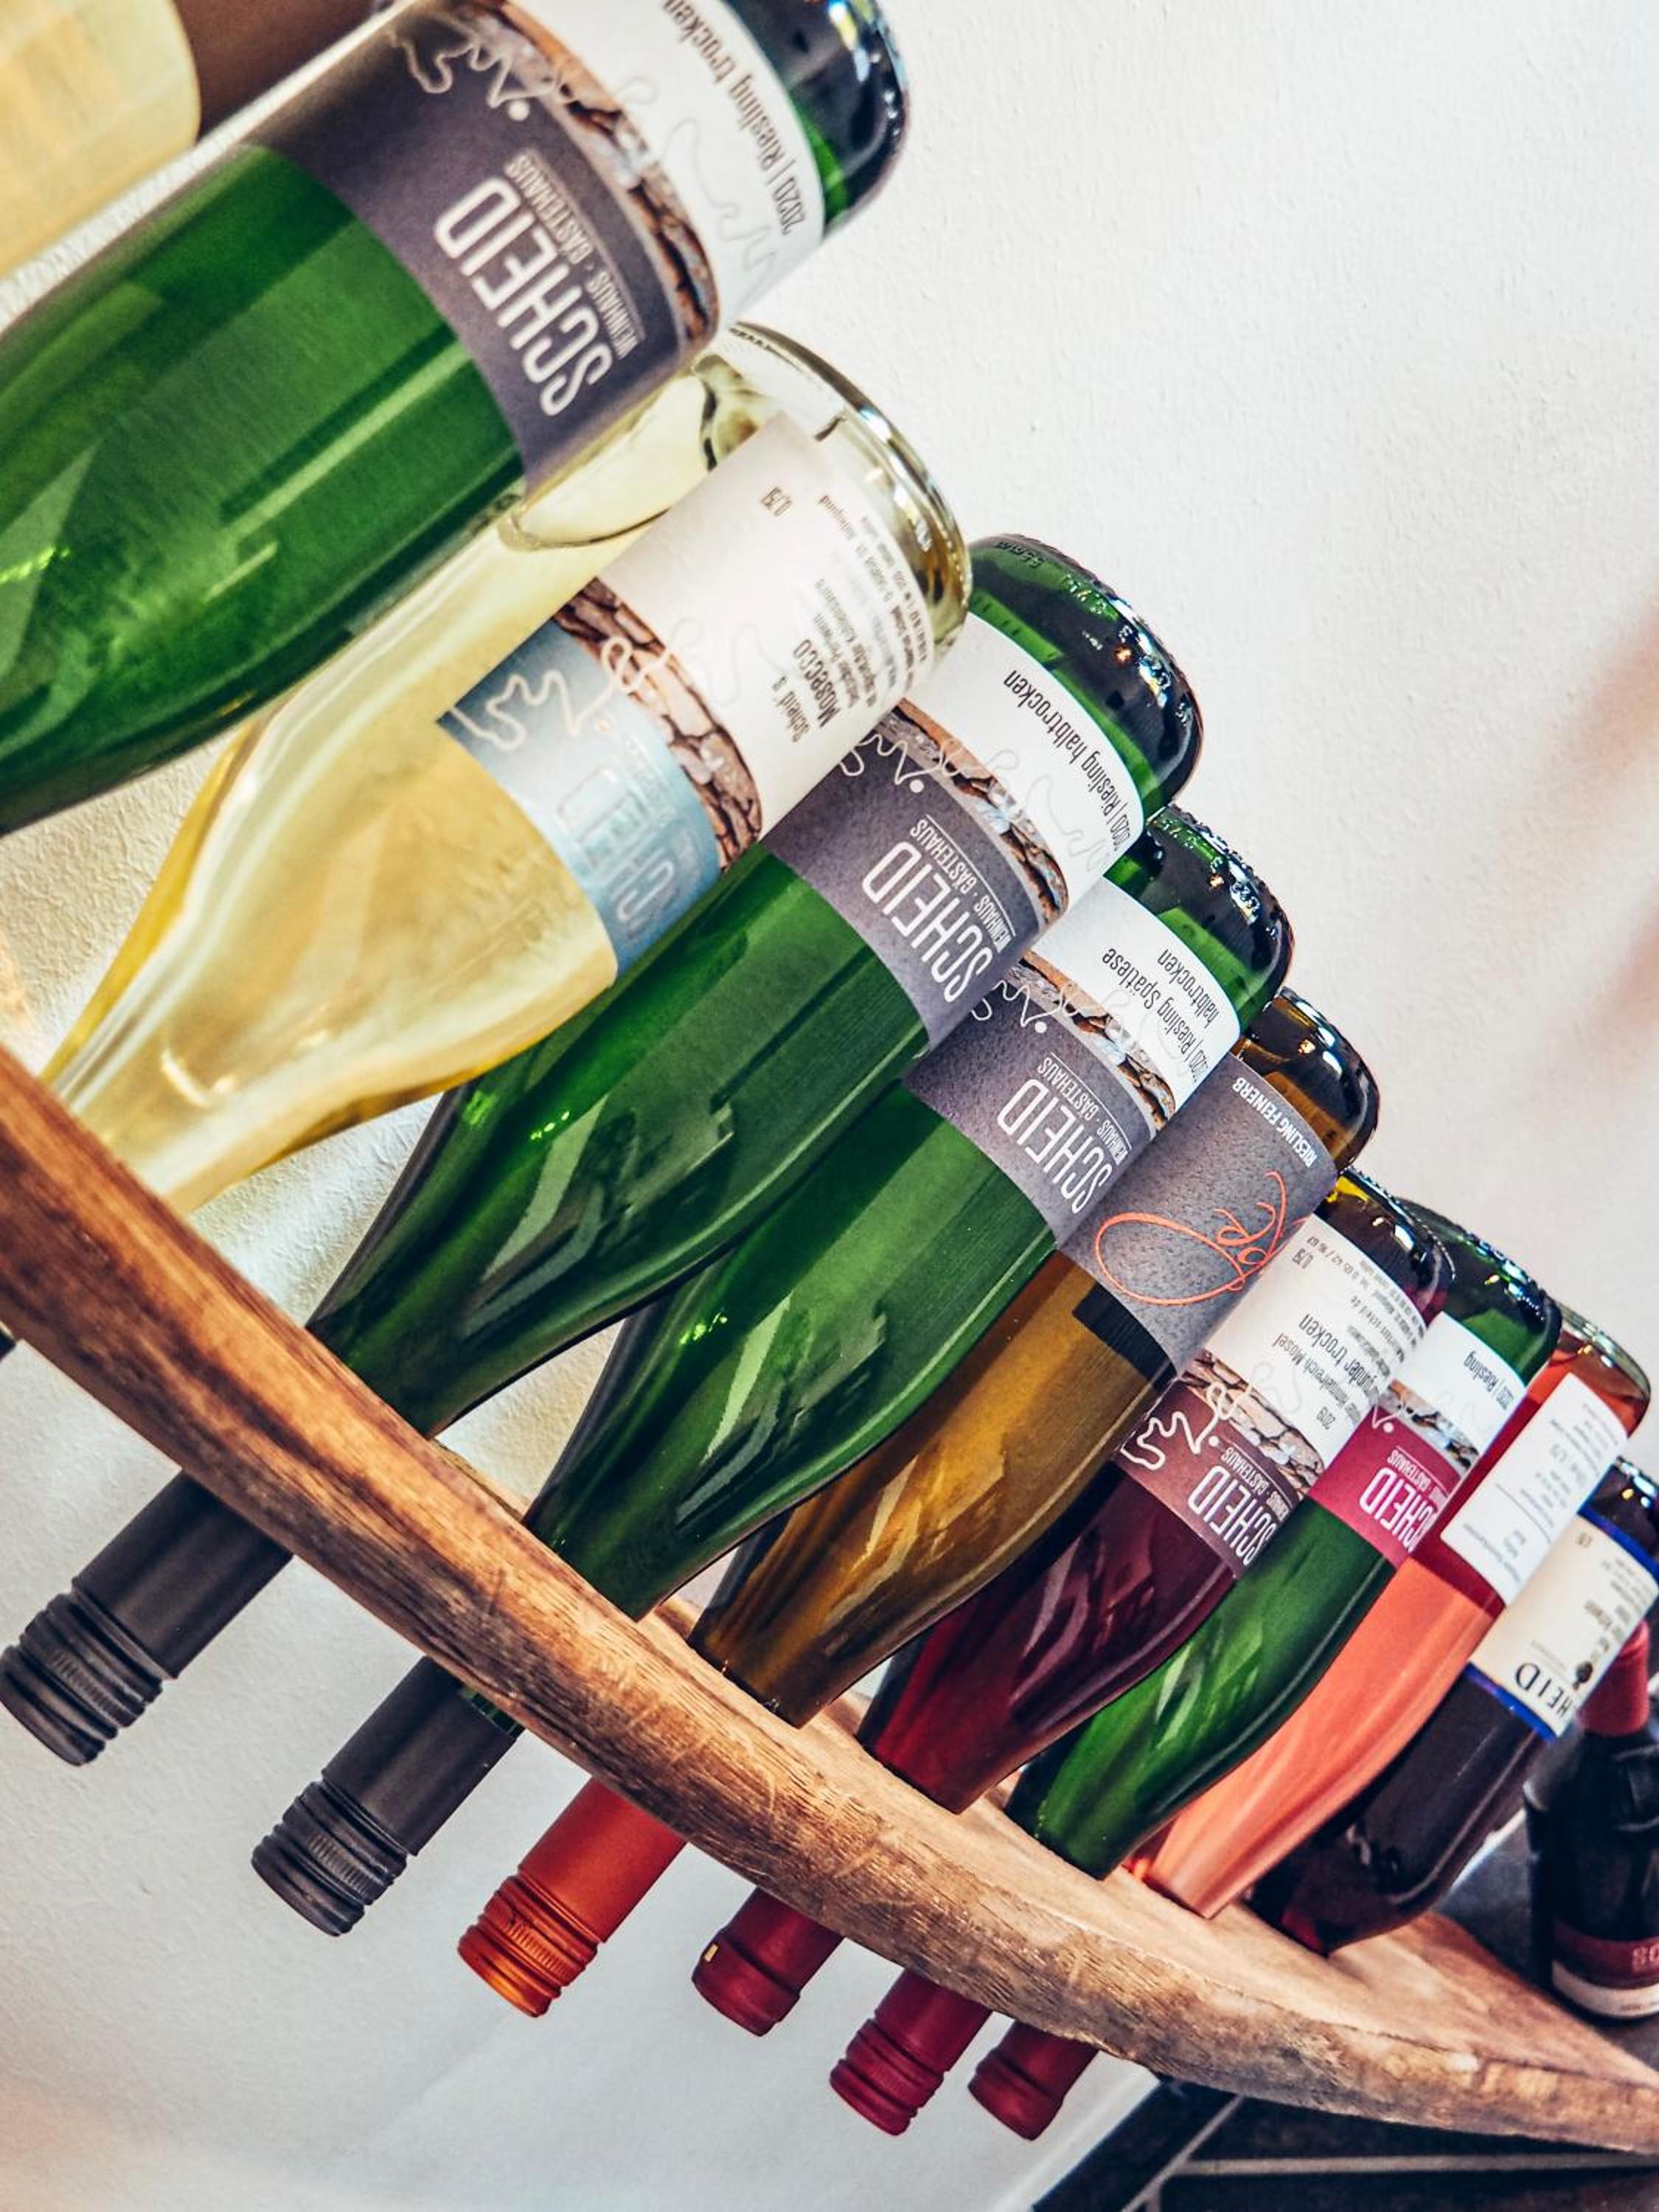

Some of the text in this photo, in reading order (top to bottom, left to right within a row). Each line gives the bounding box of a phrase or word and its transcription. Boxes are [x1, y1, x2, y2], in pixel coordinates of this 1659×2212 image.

[662, 0, 736, 84] trocken
[728, 74, 785, 172] Riesling
[772, 176, 805, 235] 2020
[434, 176, 613, 416] SCHEID
[504, 153, 639, 360] WEINHAUS GÄSTEHAUS
[793, 639, 840, 728] Mosecco
[1004, 670, 1088, 765] halbtrocken
[1081, 751, 1121, 816] Riesling
[863, 841, 993, 1003] SCHEID
[909, 818, 1013, 954] WEINHAUS GÄSTEHAUS
[1102, 948, 1161, 1010] Spätlese
[1157, 949, 1220, 1029] halbtrocken
[1157, 996, 1197, 1055] Riesling
[1037, 1057, 1099, 1122] GÄSTEHAUS
[1232, 1077, 1318, 1168] RIESLING FEINERB
[997, 1079, 1113, 1214] SCHEID
[1273, 1332, 1307, 1366] Mosel
[1298, 1312, 1348, 1368] trocken
[1463, 1350, 1499, 1393] Riesling
[1303, 1357, 1350, 1408] Himmelreich
[1220, 1447, 1270, 1496] GÄSTEHAUS
[1188, 1465, 1278, 1566] SCHEID
